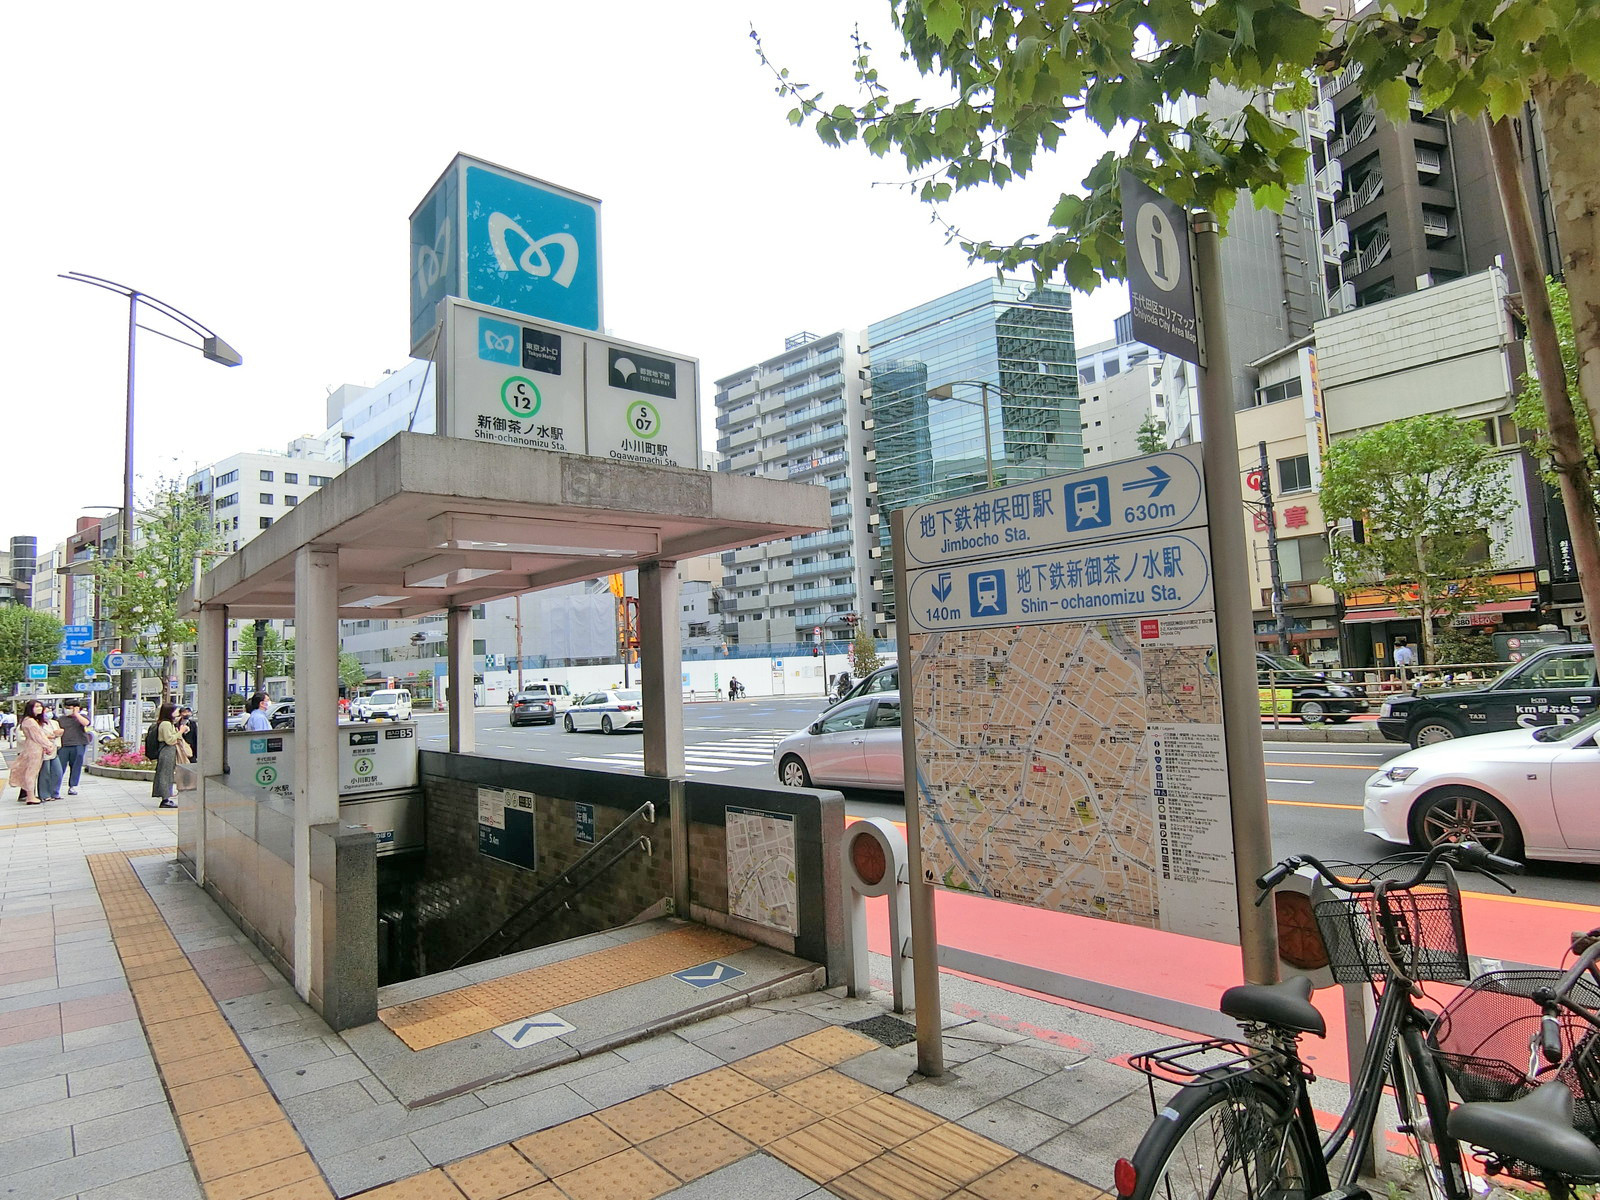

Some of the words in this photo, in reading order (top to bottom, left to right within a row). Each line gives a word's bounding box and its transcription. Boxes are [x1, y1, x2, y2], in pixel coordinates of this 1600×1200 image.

[1132, 292, 1196, 330] 千代田区エリアマップ
[1133, 306, 1158, 326] Chiyoda
[1158, 317, 1171, 333] City
[1171, 323, 1185, 338] Area
[1185, 330, 1197, 345] Map
[525, 342, 558, 356] 東京メトロ
[527, 350, 542, 359] Tokyo
[639, 367, 671, 380] 都営地下鉄
[517, 383, 526, 396] C
[513, 395, 532, 410] 12
[640, 406, 648, 418] S
[477, 414, 564, 441] 新御茶ノ水駅
[635, 418, 652, 431] 07
[474, 429, 549, 449] Shin-ochanomizu
[551, 440, 567, 452] Sta.
[621, 438, 668, 457] 小川町駅
[919, 488, 1054, 539] 地下鉄神保町駅
[1124, 502, 1176, 523] 630m
[940, 530, 999, 554] Jimbocho
[1004, 527, 1031, 544] Sta.
[1016, 545, 1184, 594] 地下鉄新御茶ノ水駅
[1021, 588, 1145, 614] Shin-ochanomizu
[1151, 585, 1182, 602] Sta.
[926, 607, 961, 622] 140m
[399, 728, 412, 738] B5
[350, 775, 378, 784] 小川町駅
